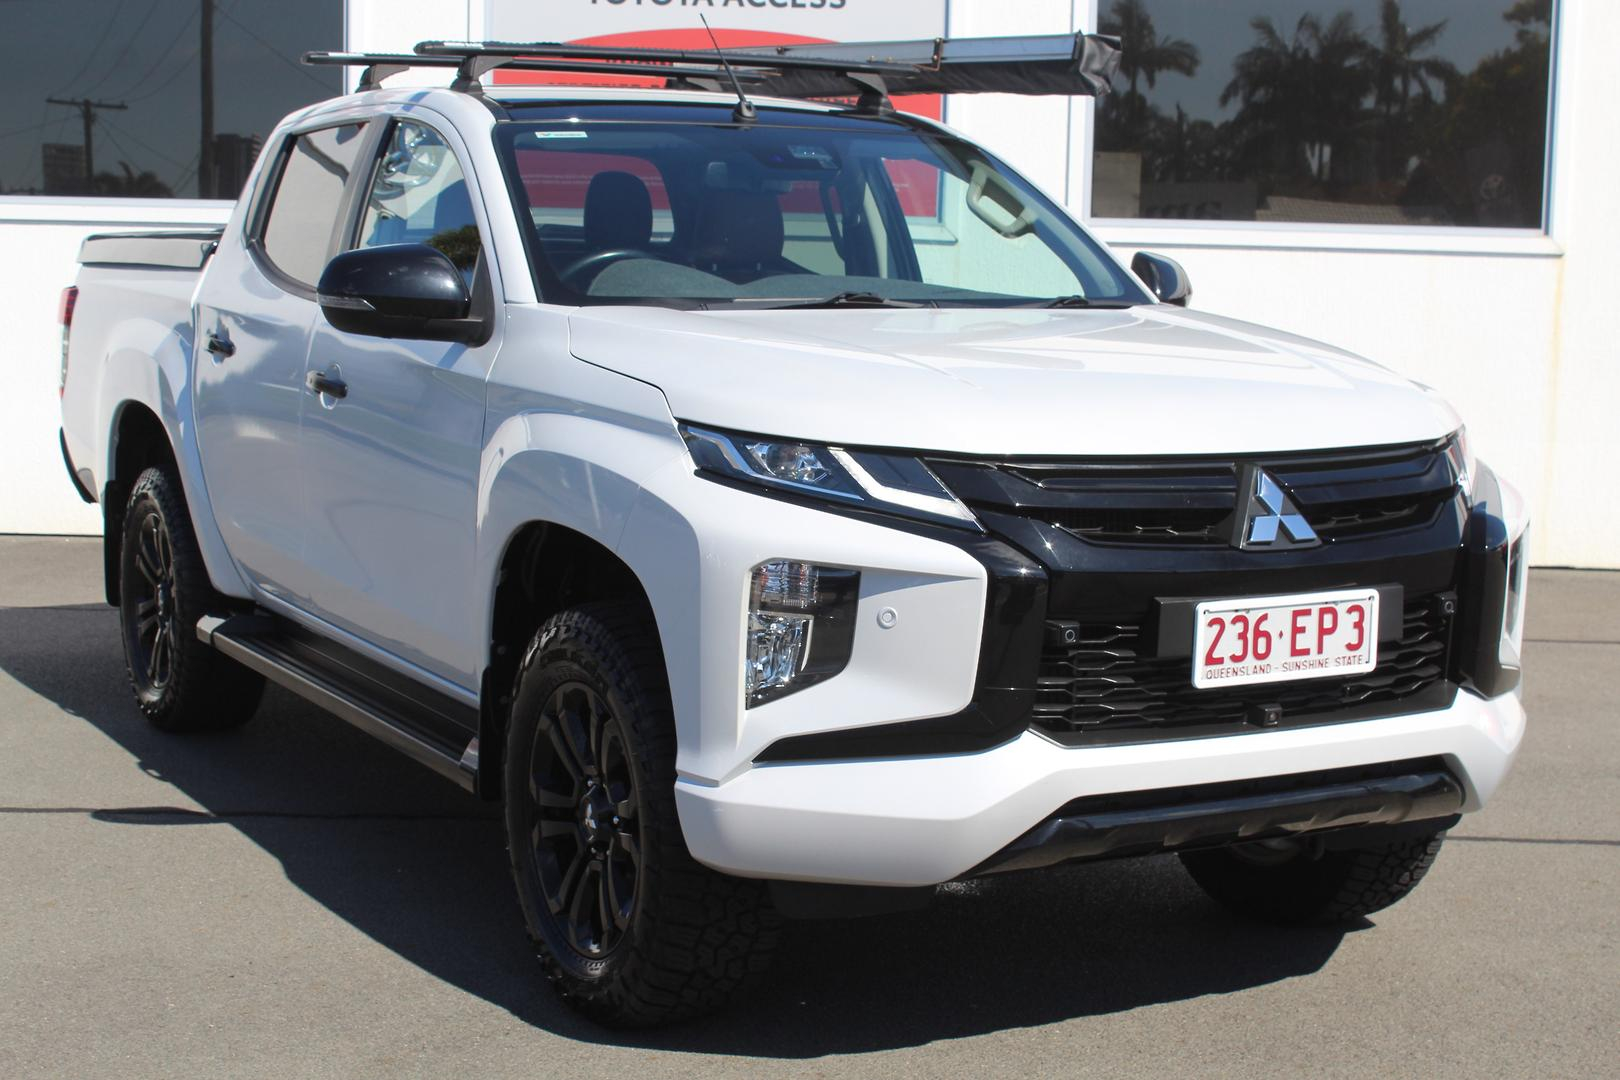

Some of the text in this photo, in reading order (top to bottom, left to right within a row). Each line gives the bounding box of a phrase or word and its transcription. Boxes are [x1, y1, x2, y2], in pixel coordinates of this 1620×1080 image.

[1205, 663, 1272, 680] QUEENSLAND
[1281, 657, 1330, 673] SUNSHINE
[1335, 654, 1363, 668] STATE
